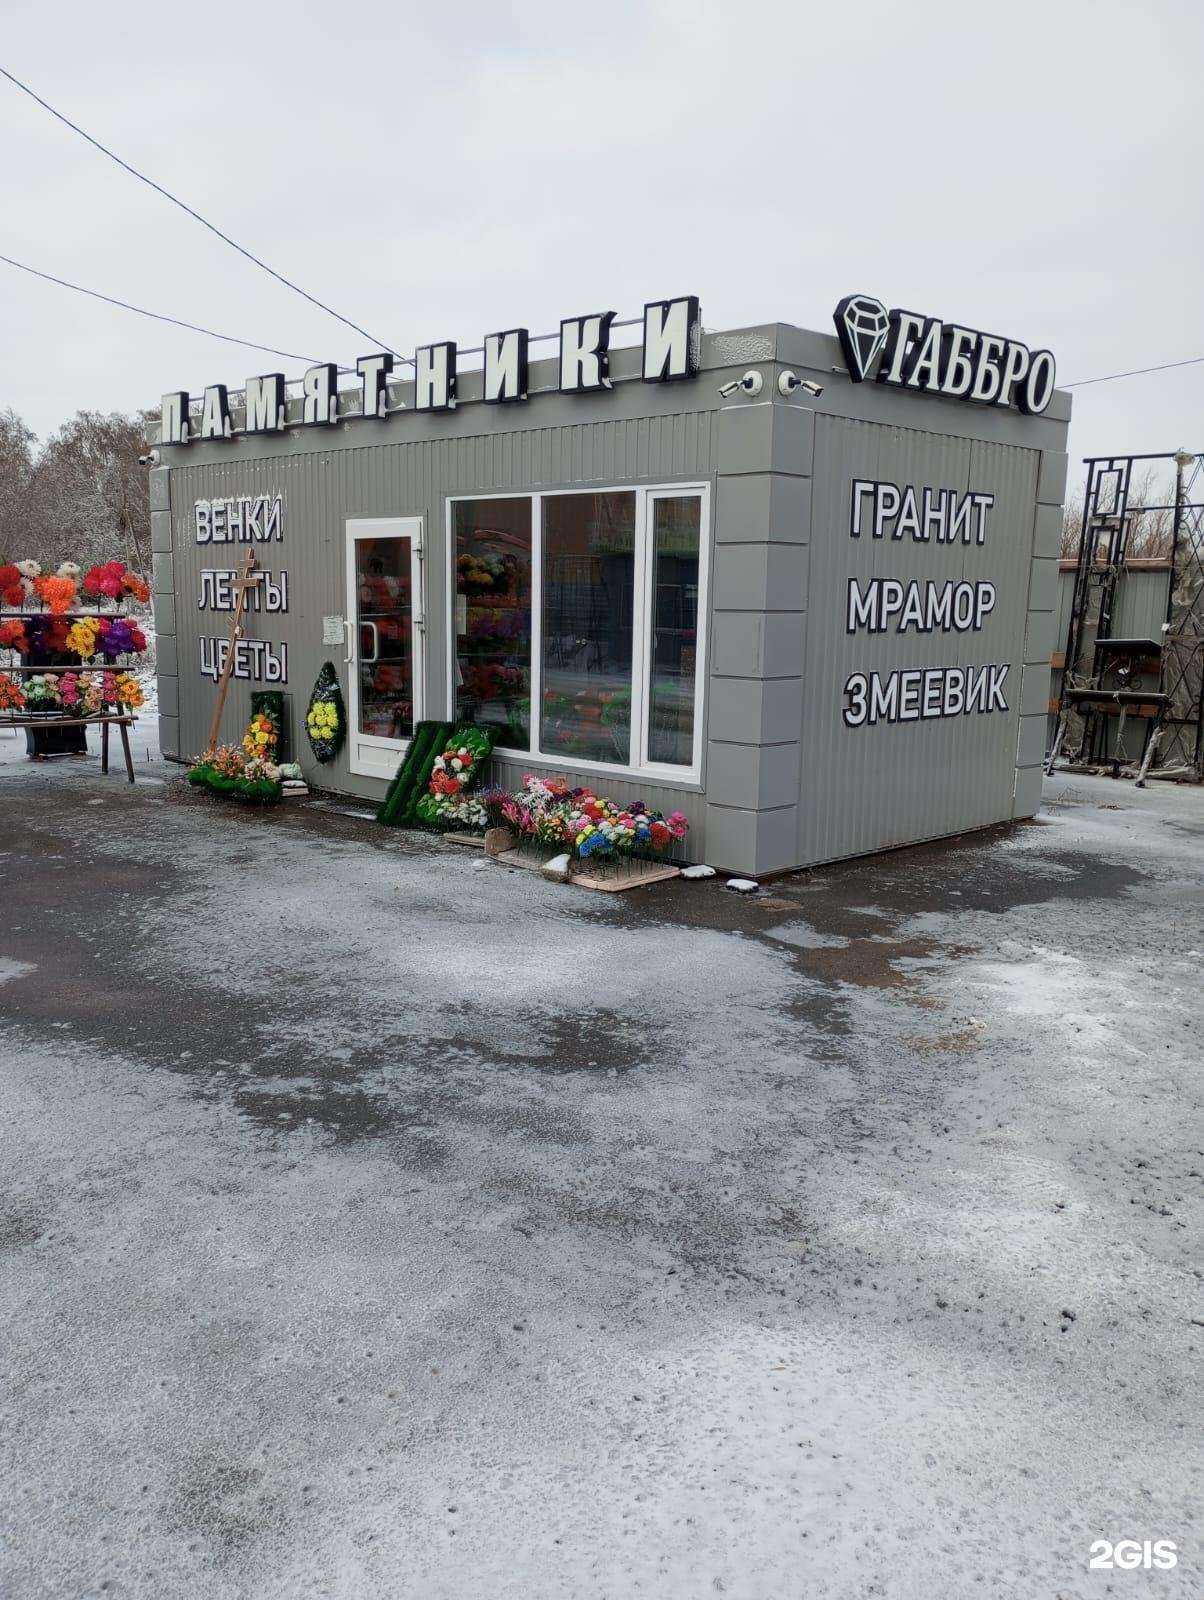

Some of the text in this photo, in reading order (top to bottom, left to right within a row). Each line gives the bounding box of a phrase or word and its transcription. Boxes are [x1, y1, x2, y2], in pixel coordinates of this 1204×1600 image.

[161, 296, 699, 446] ПАМЯТНИКИ
[877, 308, 1056, 415] ГАББРО
[195, 495, 284, 544] ВЕНКИ
[850, 478, 995, 545] ГРАНИТ
[847, 577, 997, 634] МРАМОР
[200, 636, 288, 684] ЦВЕТЫ
[843, 664, 1010, 728] ЗМЕЕВИК
